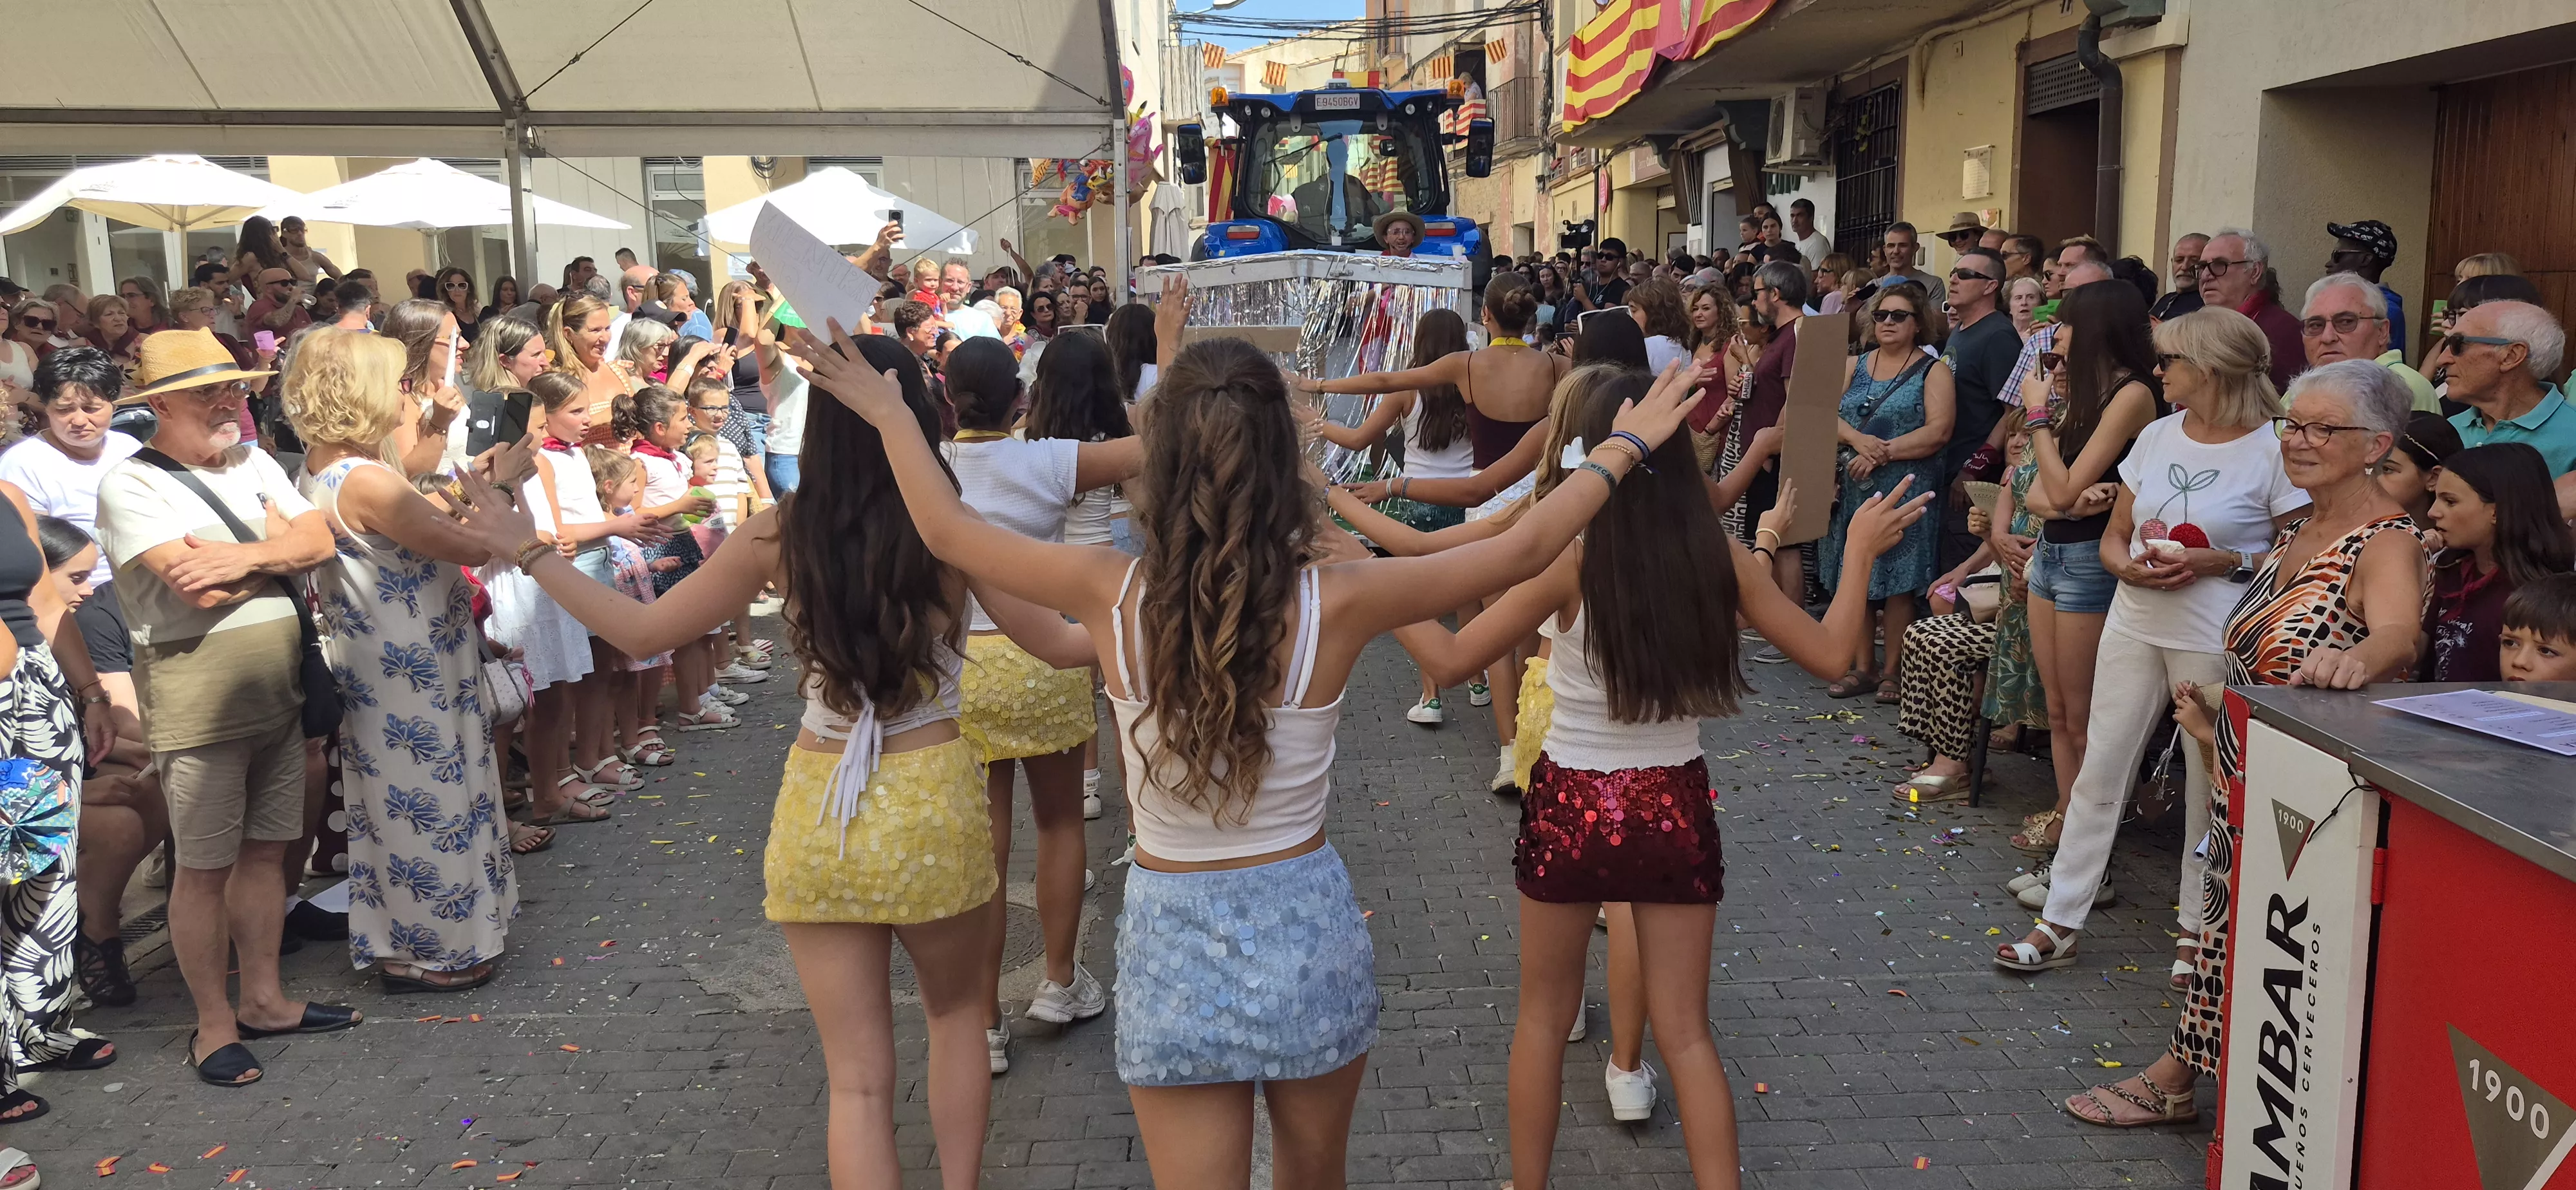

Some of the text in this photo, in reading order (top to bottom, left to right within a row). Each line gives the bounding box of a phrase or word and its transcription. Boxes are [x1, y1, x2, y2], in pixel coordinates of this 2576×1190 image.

[1743, 373, 1751, 398] AMBAR
[2278, 809, 2304, 834] 1900
[2249, 893, 2309, 1190] MBAR
[2302, 922, 2321, 1092] CERVECEROS
[2469, 1059, 2550, 1140] 1900
